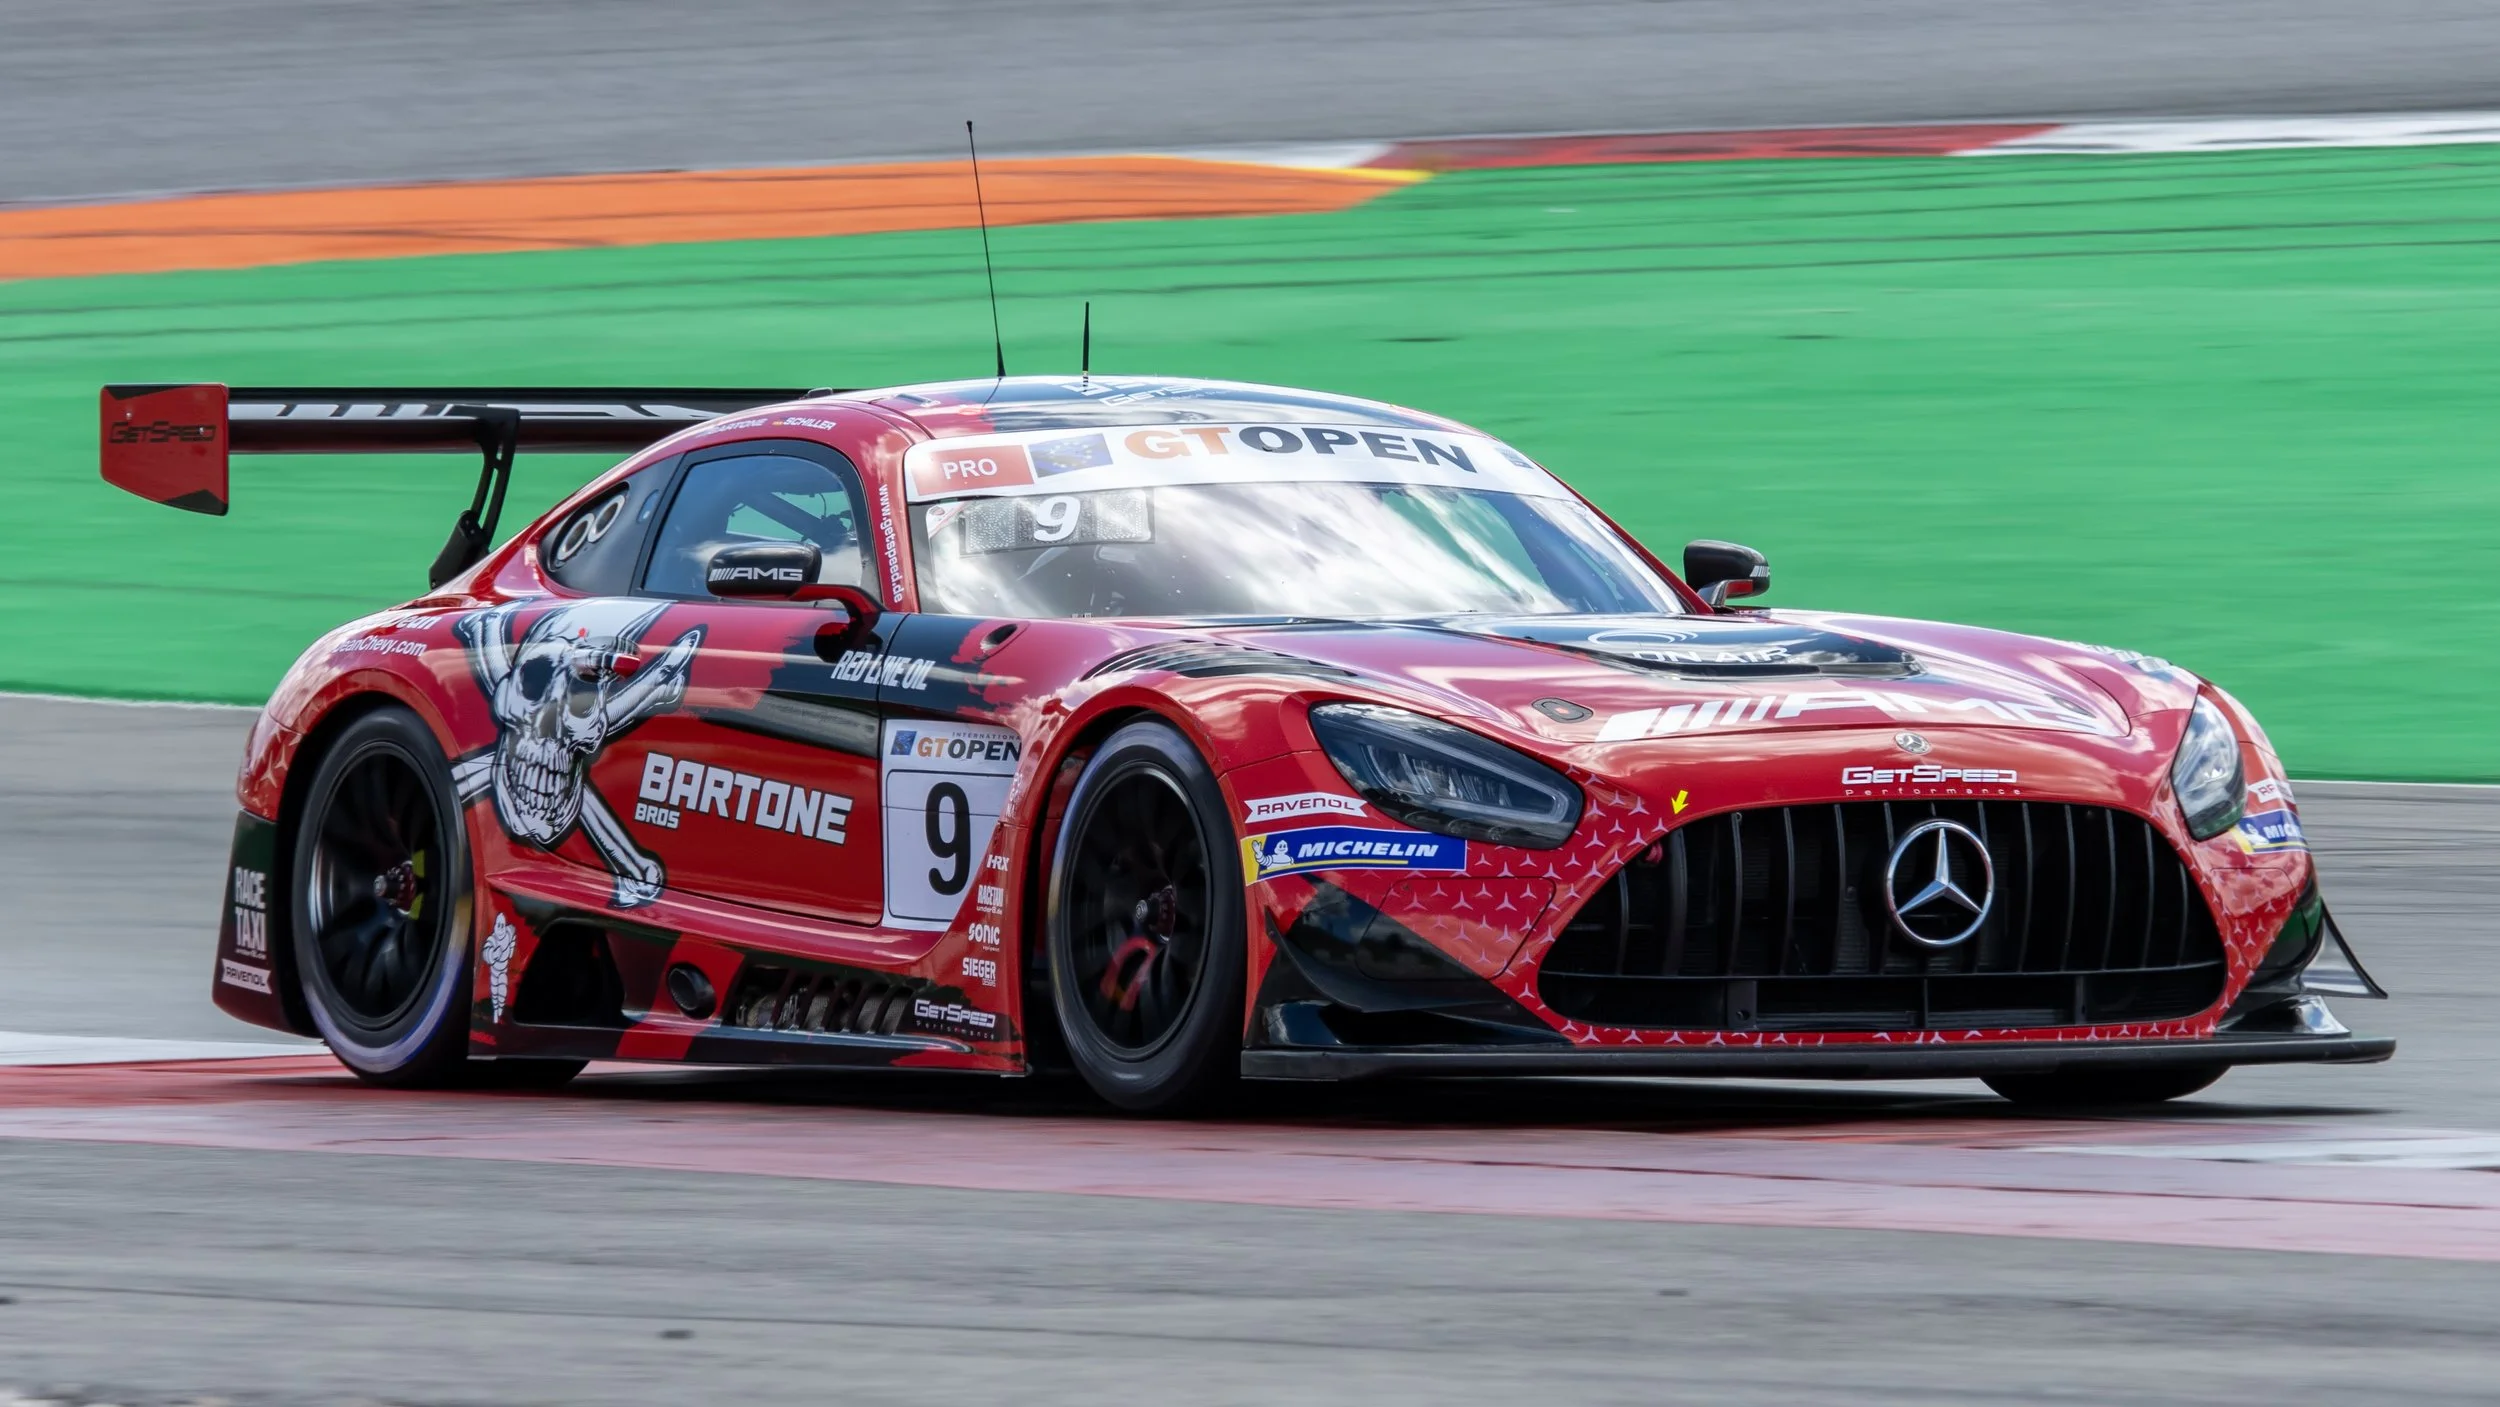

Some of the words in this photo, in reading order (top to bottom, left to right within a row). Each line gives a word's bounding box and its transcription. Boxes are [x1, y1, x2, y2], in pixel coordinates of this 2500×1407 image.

[109, 420, 217, 444] GETSPEED
[783, 416, 837, 431] SCHILLER
[941, 458, 998, 480] PRO
[1033, 495, 1081, 542] 9
[878, 484, 905, 603] www.getspeed.de
[730, 567, 803, 581] AMG
[1714, 646, 1793, 664] AIR
[830, 650, 872, 681] RED
[863, 654, 911, 688] LINE
[902, 658, 936, 691] OIL
[1841, 764, 2018, 785] GETSPEED
[638, 751, 853, 845] BARTONE
[1256, 797, 1356, 816] RAVENOL
[633, 802, 681, 830] BROS
[925, 781, 971, 896] 9
[1296, 840, 1439, 859] MICHELIN
[234, 866, 267, 909] RACE
[234, 906, 267, 952] TAXI
[225, 966, 266, 987] RAVENOL
[962, 956, 997, 980] SIEGER
[914, 998, 997, 1029] GETSPEED
